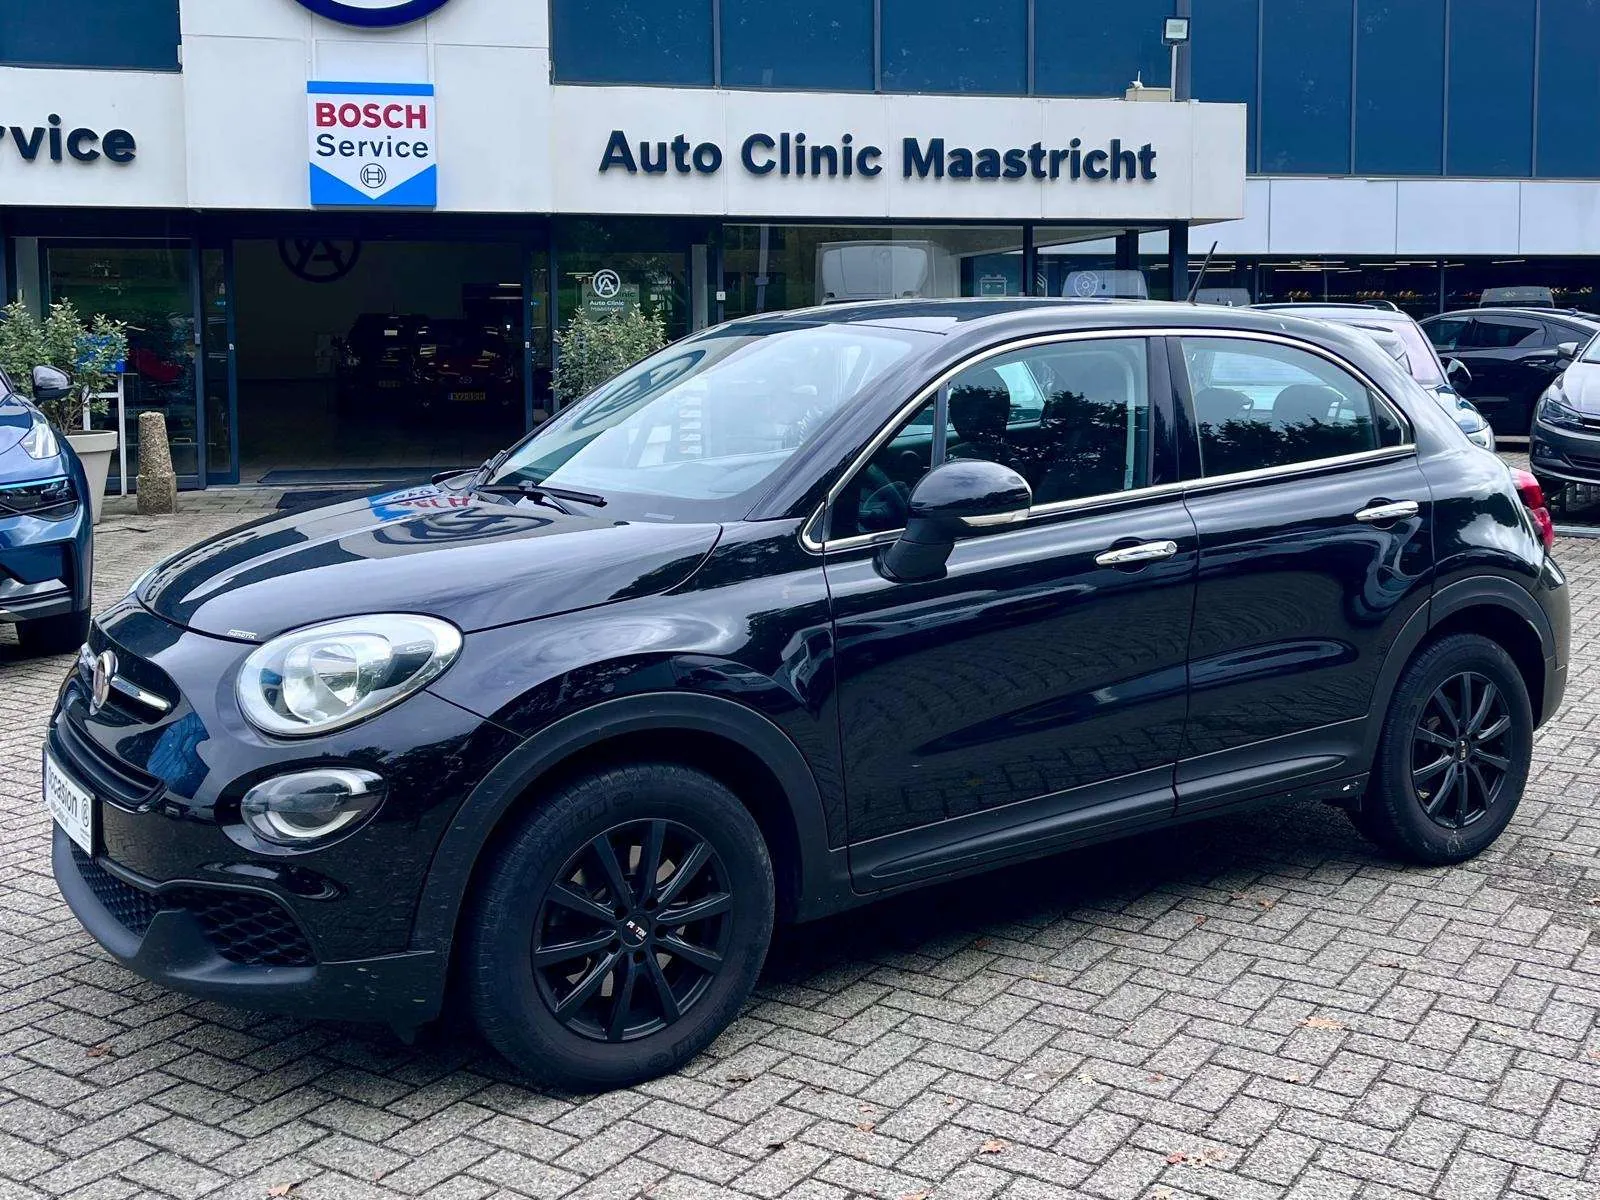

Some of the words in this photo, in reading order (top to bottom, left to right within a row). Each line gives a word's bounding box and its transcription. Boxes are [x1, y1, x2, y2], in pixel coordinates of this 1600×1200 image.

[316, 102, 427, 129] BOSCH
[316, 133, 429, 158] Service
[599, 130, 723, 173] Auto
[741, 132, 883, 177] Clinic
[902, 137, 1158, 180] Maastricht
